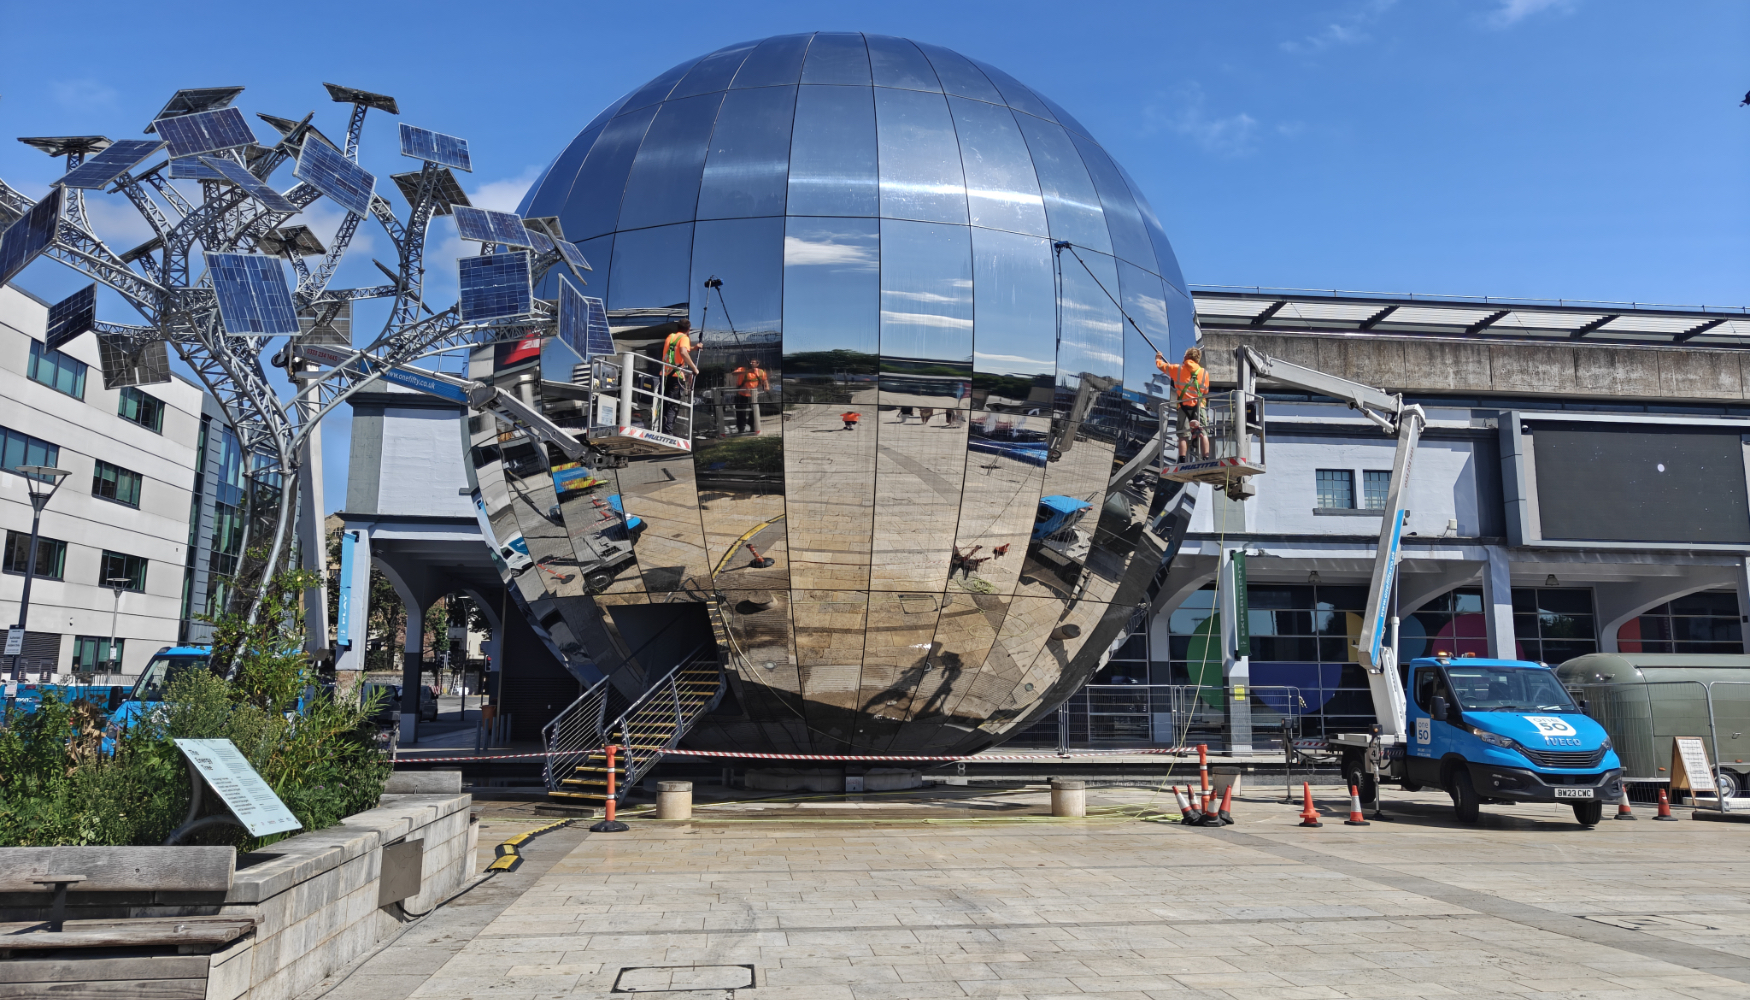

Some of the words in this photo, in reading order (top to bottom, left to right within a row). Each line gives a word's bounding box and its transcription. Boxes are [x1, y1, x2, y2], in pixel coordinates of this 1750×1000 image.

[645, 433, 676, 445] MULTITEL
[1179, 461, 1219, 471] MULTITEL
[1418, 721, 1429, 729] one
[1539, 723, 1568, 731] 50
[1418, 730, 1429, 740] 50
[1545, 736, 1581, 746] IVECO
